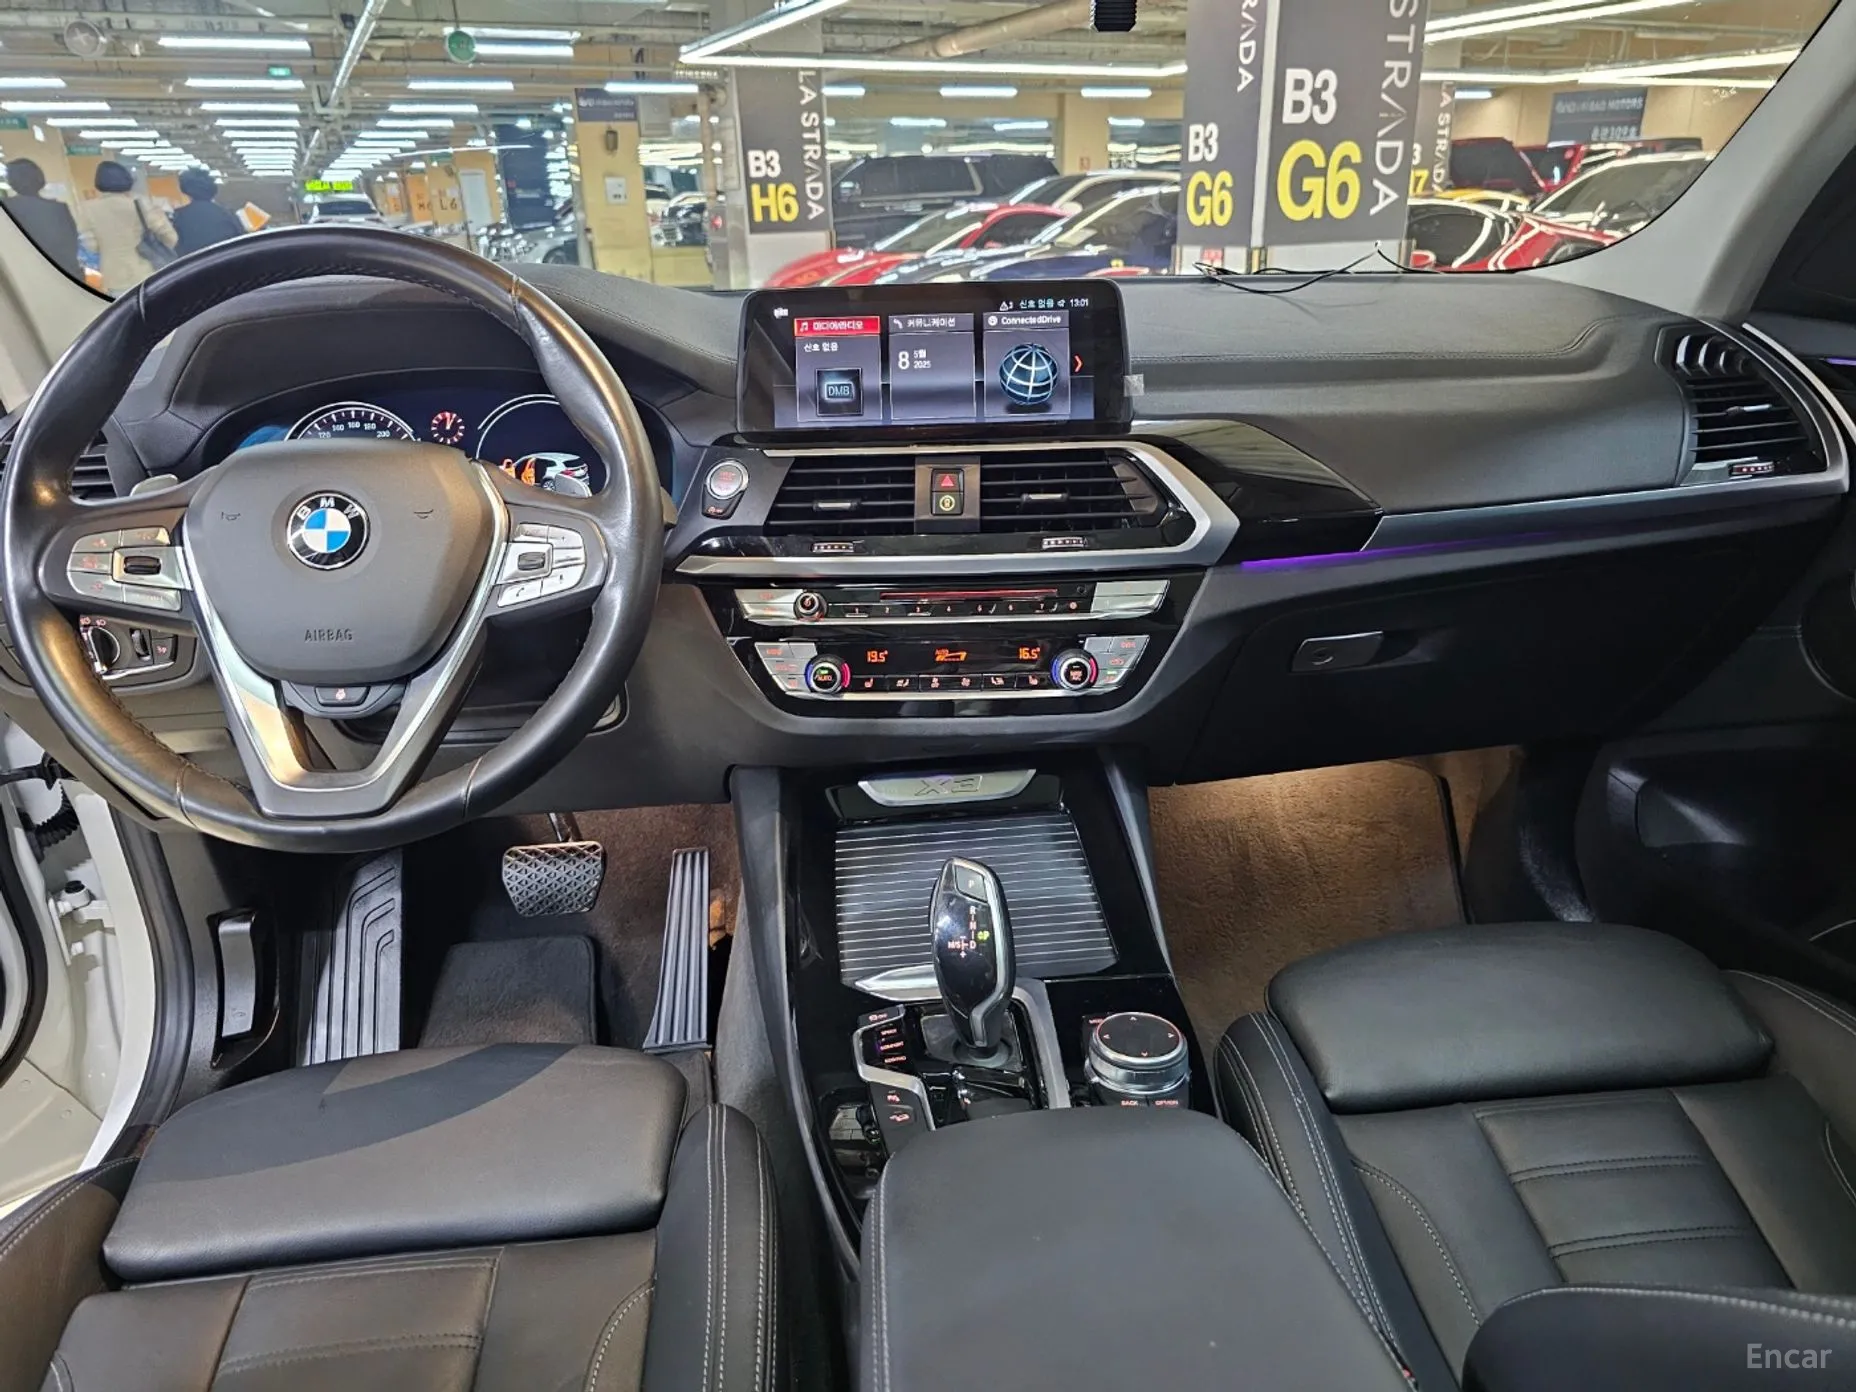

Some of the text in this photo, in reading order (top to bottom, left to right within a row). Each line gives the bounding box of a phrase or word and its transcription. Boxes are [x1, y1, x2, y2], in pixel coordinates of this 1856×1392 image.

[1282, 68, 1338, 124] B3
[798, 70, 826, 220] LA STRADA
[1188, 122, 1219, 162] B3
[747, 150, 781, 178] B3
[1277, 139, 1362, 221] G6
[751, 182, 799, 222] H6
[1186, 170, 1233, 226] G6
[898, 351, 909, 370] 8
[827, 386, 850, 397] DMB
[304, 628, 353, 641] AIRBAG
[914, 775, 983, 797] X3
